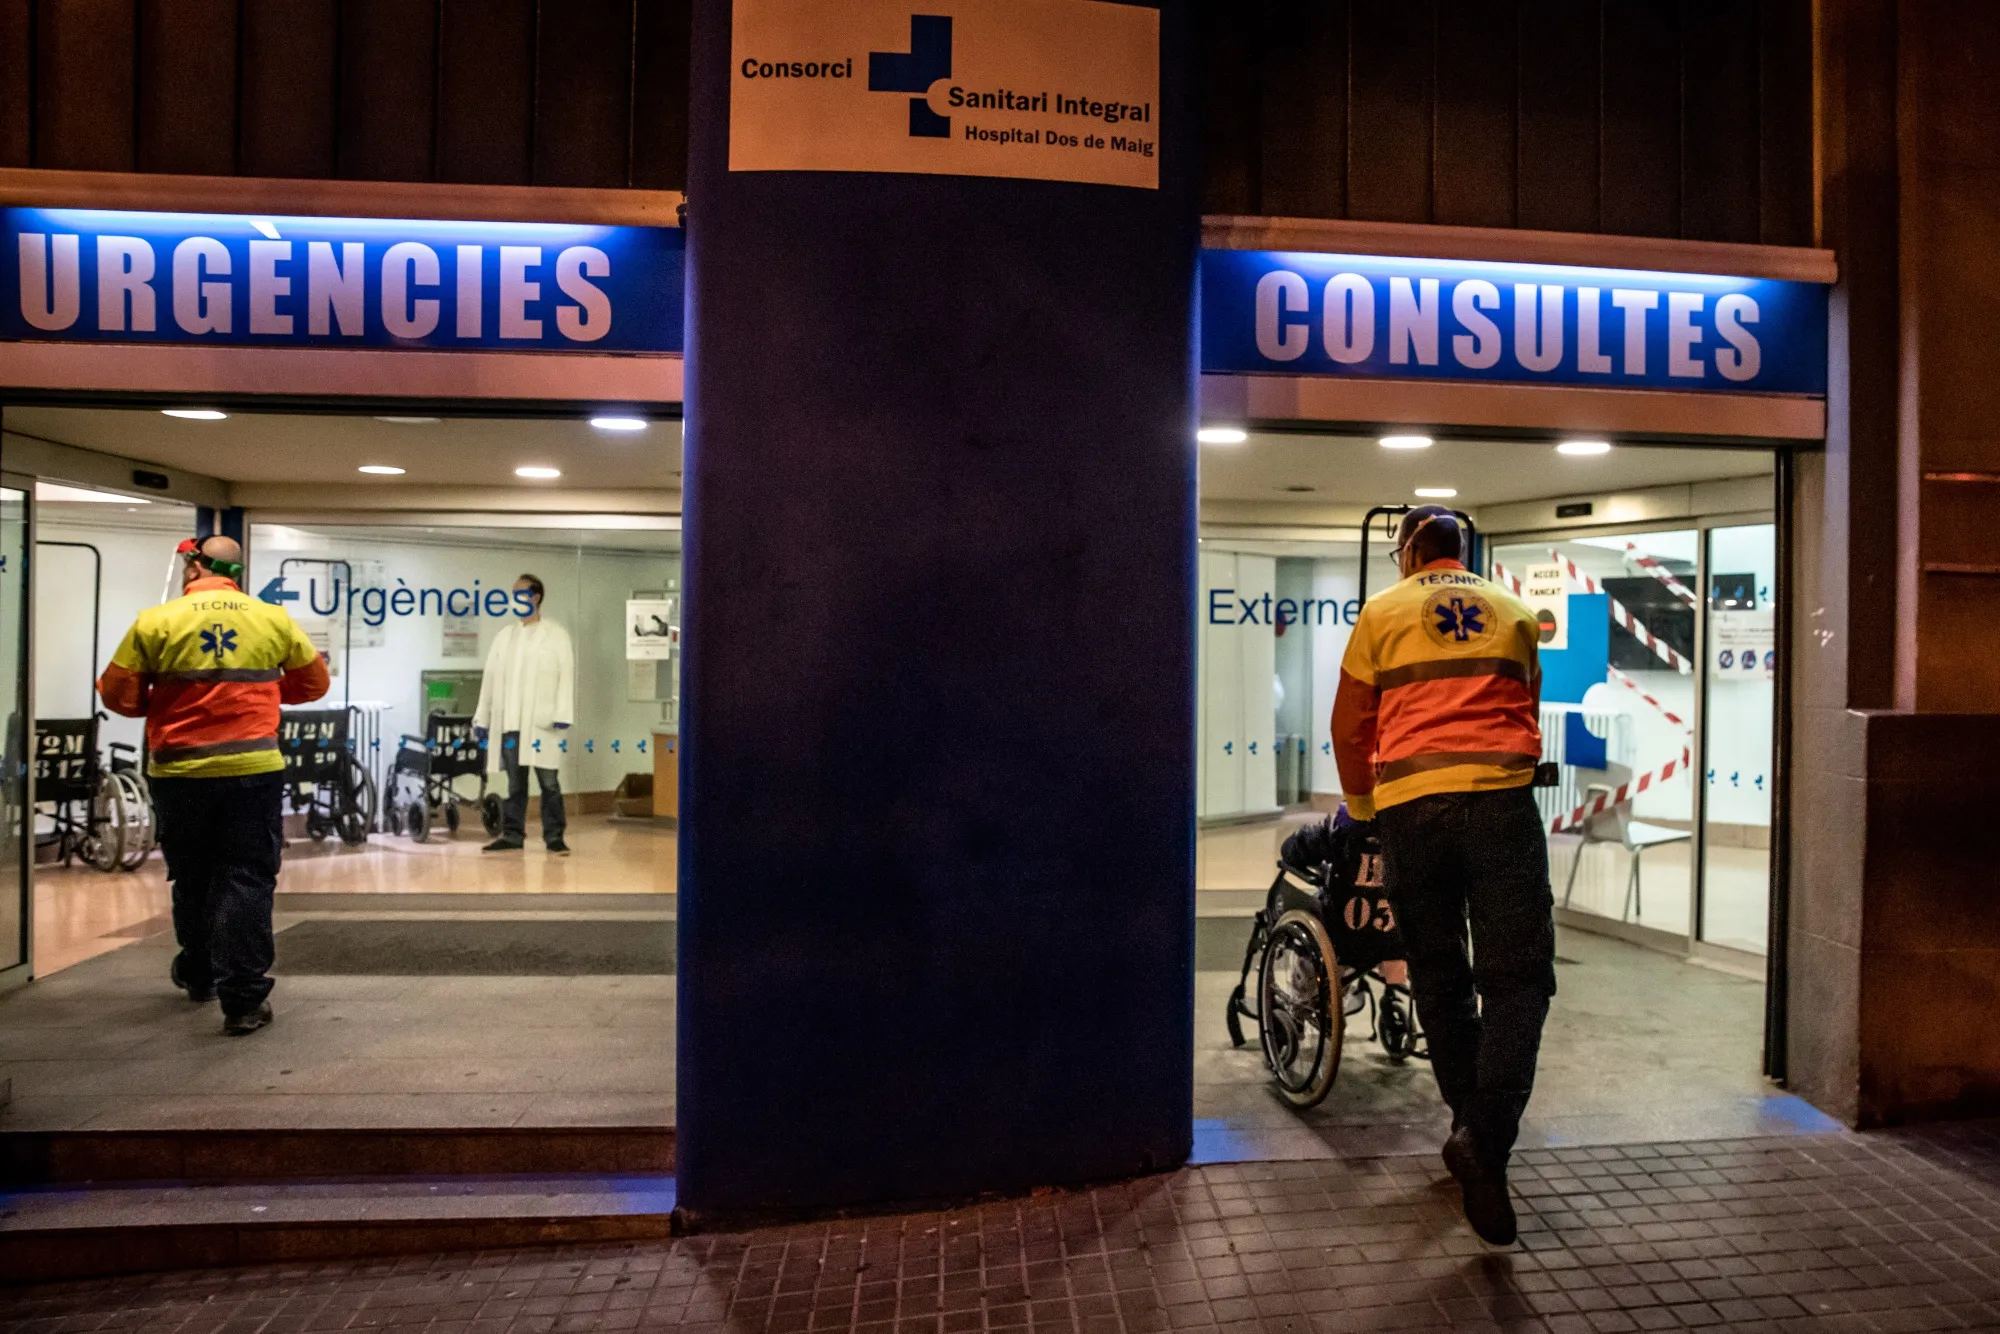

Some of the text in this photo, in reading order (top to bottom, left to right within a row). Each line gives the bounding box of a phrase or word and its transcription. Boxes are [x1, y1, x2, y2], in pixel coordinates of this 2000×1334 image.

[741, 58, 852, 79] Consorci
[948, 87, 1150, 123] Sanitari Integral
[965, 126, 1154, 157] Hospital Dos de Maig
[18, 221, 611, 342] URGÈNCIES
[1255, 270, 1761, 382] CONSULTES
[309, 578, 535, 626] Urgències
[35, 734, 85, 755] 2M
